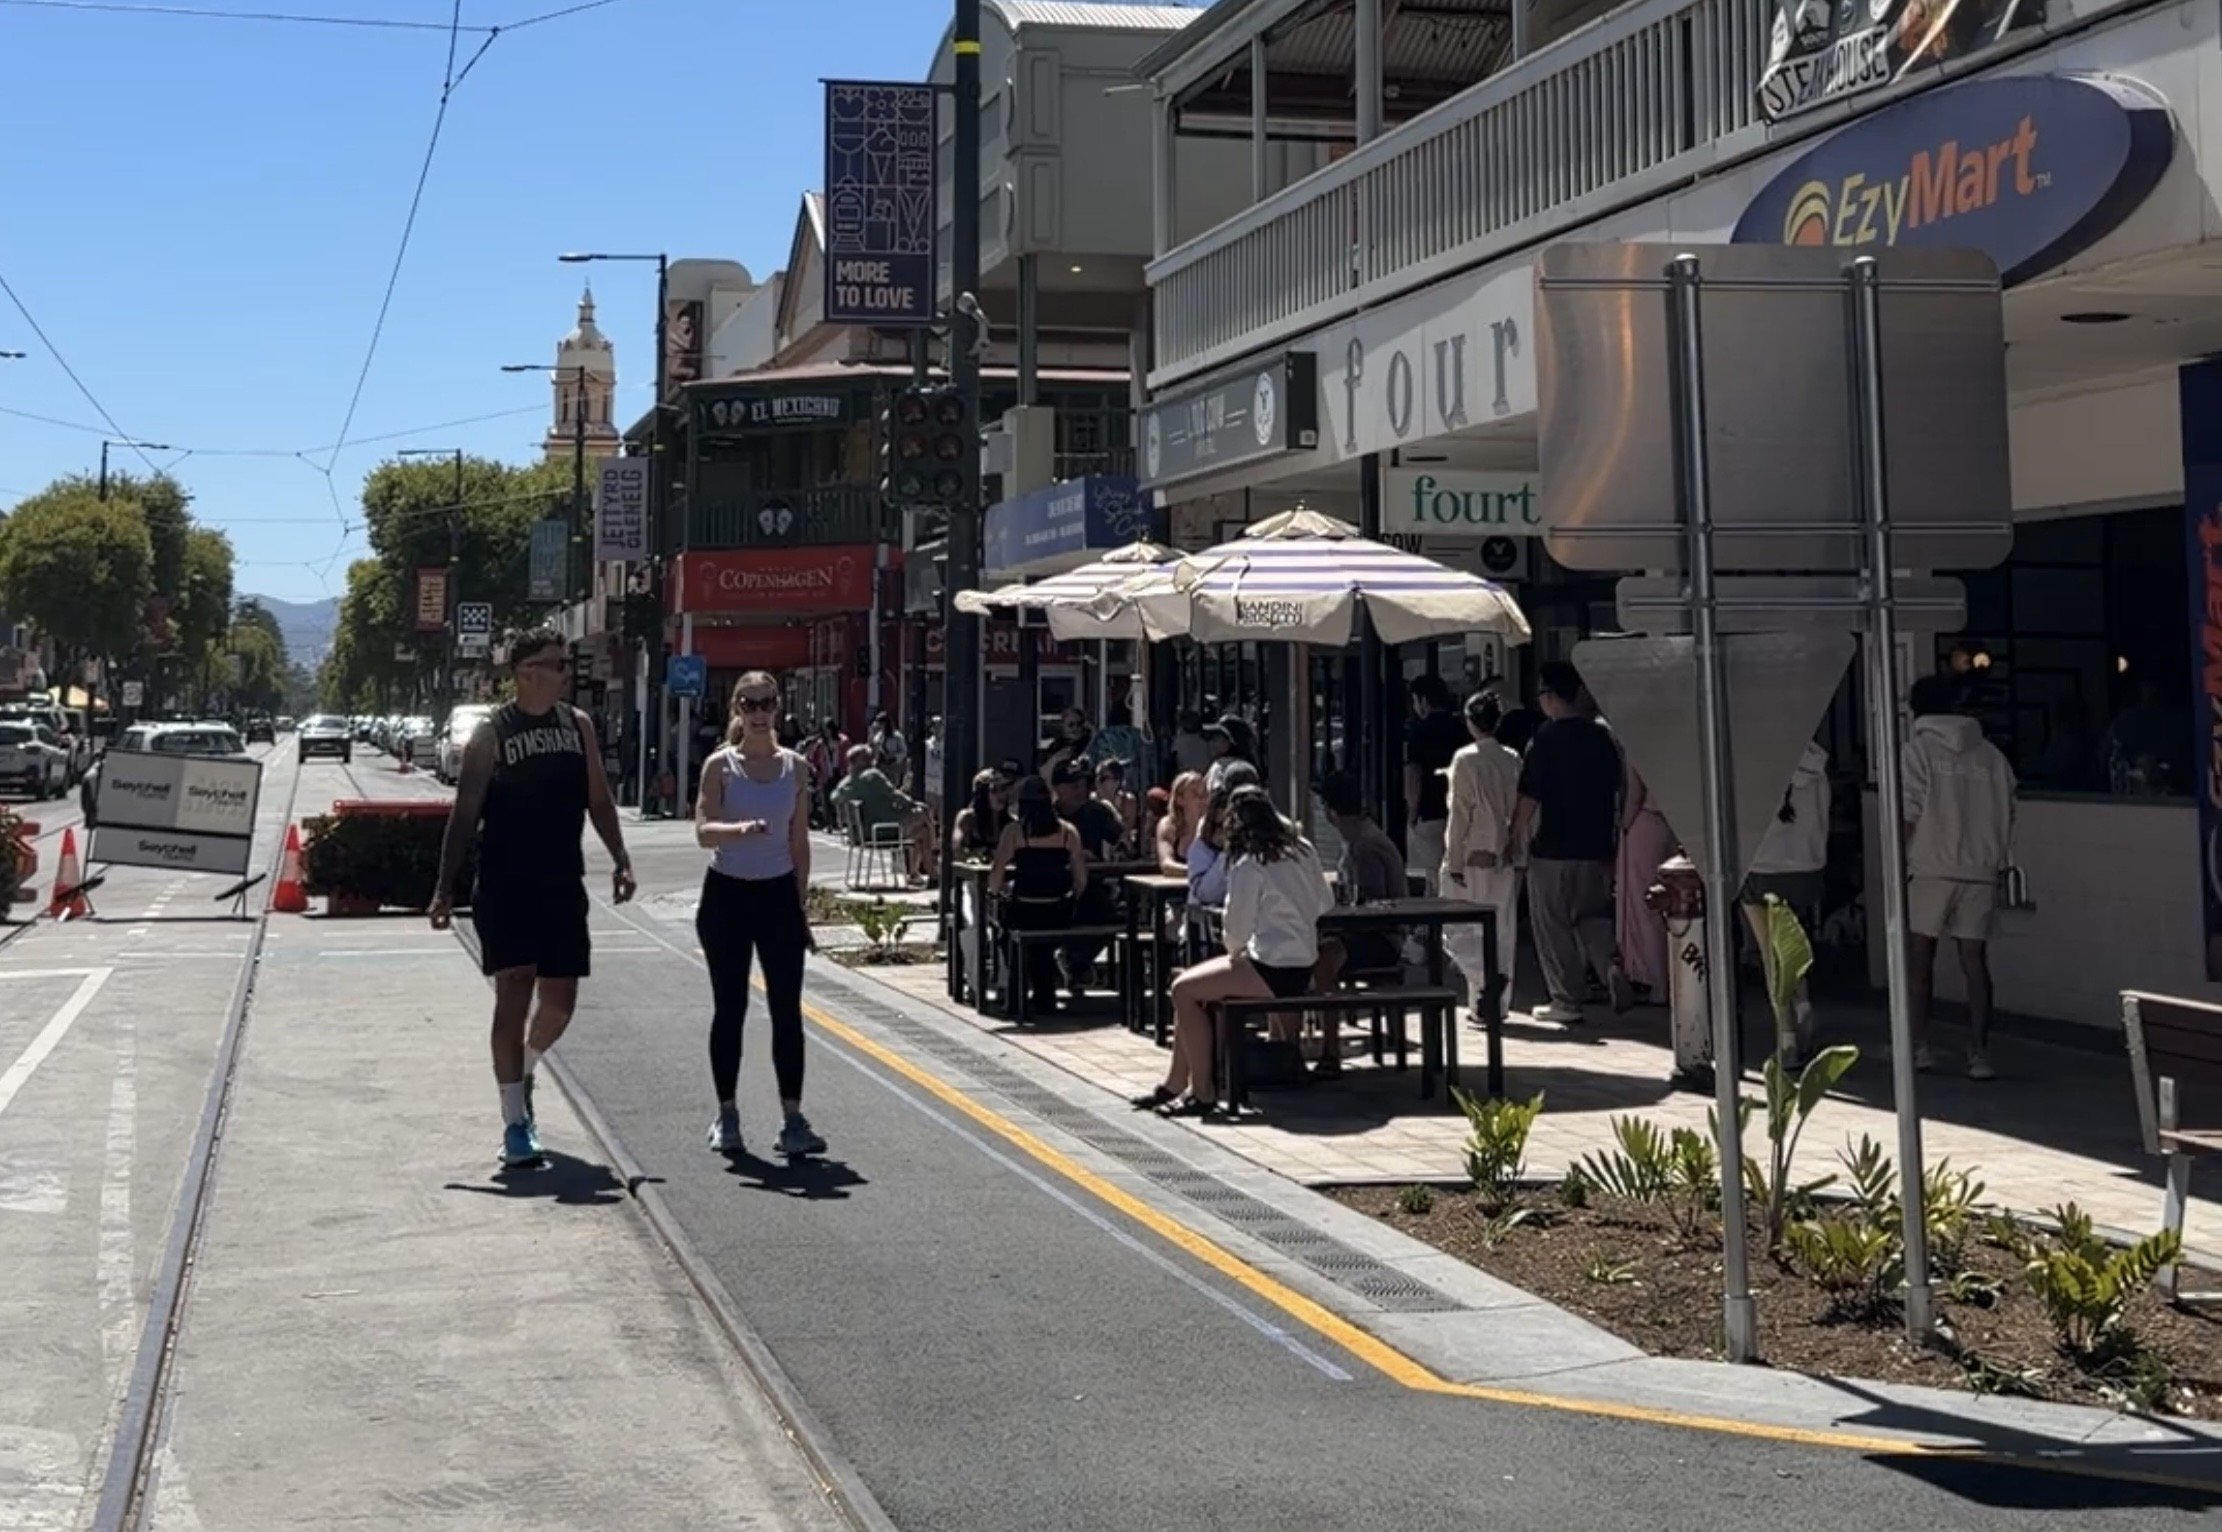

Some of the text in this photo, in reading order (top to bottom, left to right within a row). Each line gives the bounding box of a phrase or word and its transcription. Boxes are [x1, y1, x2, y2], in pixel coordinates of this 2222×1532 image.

[1832, 114, 2037, 246] EzyMart
[836, 260, 891, 283] MORE
[836, 284, 914, 309] TO LOVE
[621, 469, 643, 549] GLENELG
[719, 566, 833, 590] COPENHAGEN
[505, 727, 583, 766] GYMSHARK
